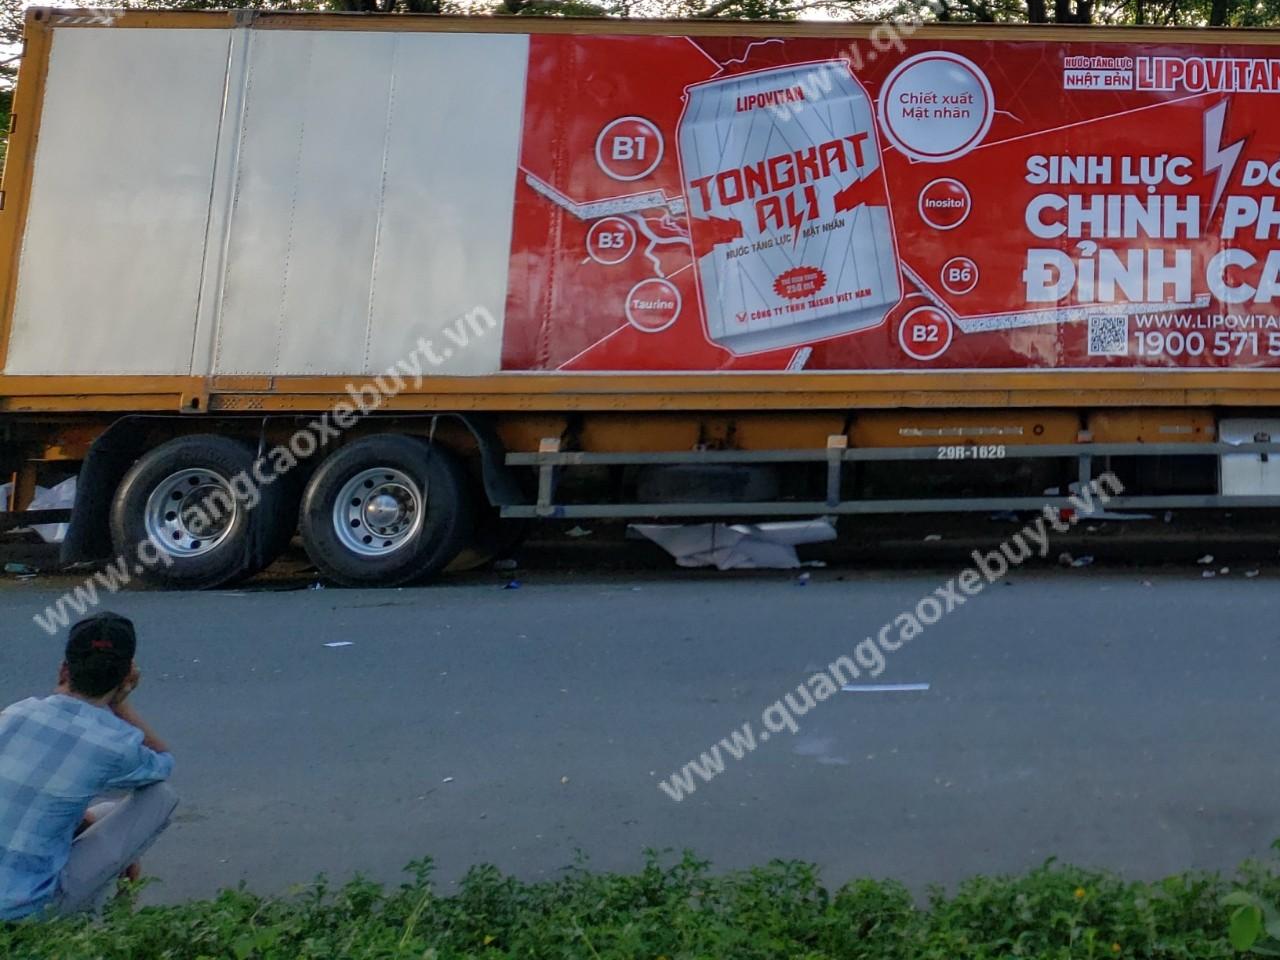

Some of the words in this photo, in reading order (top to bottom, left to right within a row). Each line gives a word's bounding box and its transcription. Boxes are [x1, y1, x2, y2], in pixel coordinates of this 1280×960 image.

[1066, 71, 1102, 89] NHẬT
[1104, 71, 1131, 88] BẢN
[736, 86, 805, 112] LIPOVITAN
[899, 91, 938, 105] Chiết
[942, 91, 974, 105] xuất
[902, 107, 930, 121] Mật
[611, 136, 647, 161] B1
[690, 131, 869, 213] TONGKAT
[1025, 155, 1112, 185] SINH
[1121, 154, 1193, 194] LỰC
[755, 185, 820, 238] ALI
[925, 198, 965, 208] Inositol
[1025, 193, 1200, 238] CHINH
[597, 232, 625, 249] B3
[948, 267, 971, 283] B6
[1022, 240, 1193, 303] ĐỈNH
[632, 298, 675, 311] Taurine
[912, 324, 939, 342] B2
[1134, 331, 1205, 357] 1900
[1213, 331, 1259, 357] 571
[938, 445, 1007, 460] 29R-1626
